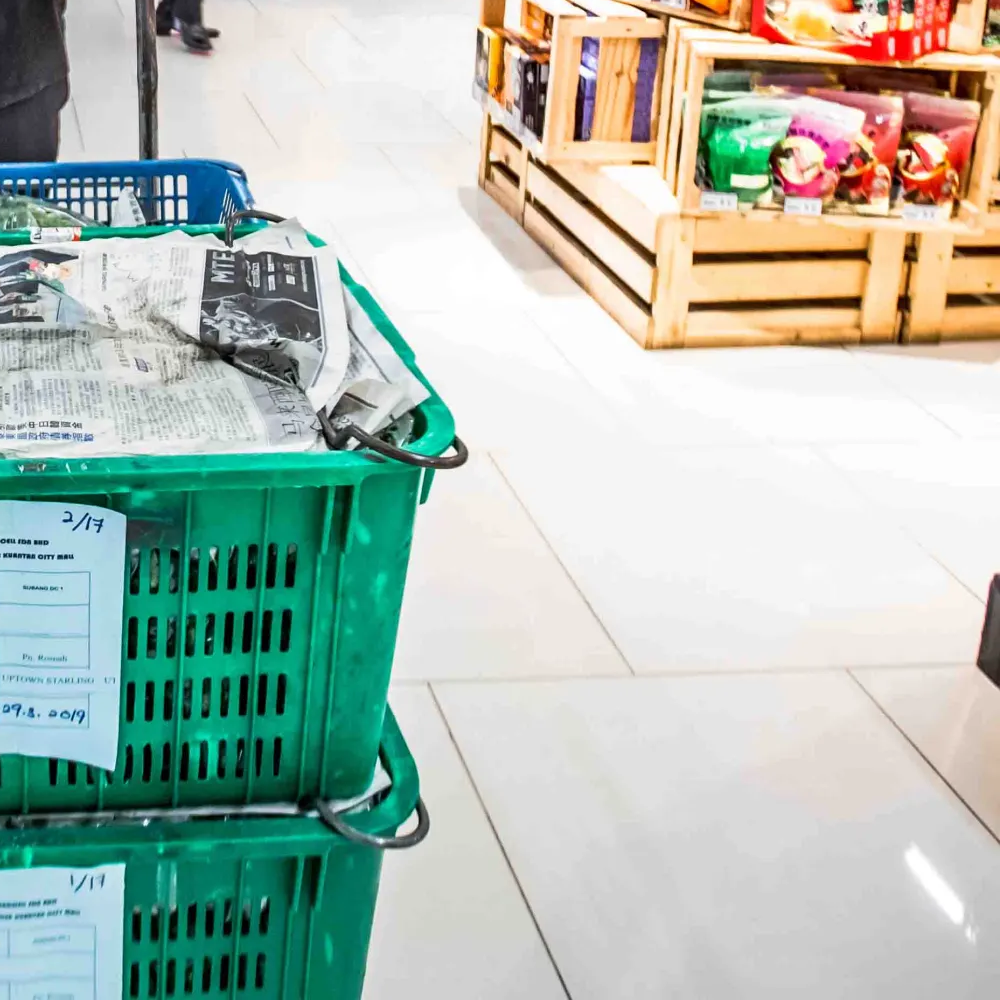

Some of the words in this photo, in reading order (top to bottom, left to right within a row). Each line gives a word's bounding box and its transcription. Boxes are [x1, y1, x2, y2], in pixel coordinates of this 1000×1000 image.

[61, 511, 105, 533] 2/17
[2, 552, 36, 560] KUANTAN
[37, 553, 55, 561] CITY
[2, 674, 44, 684] UPTOWN
[46, 676, 95, 685] STARLING
